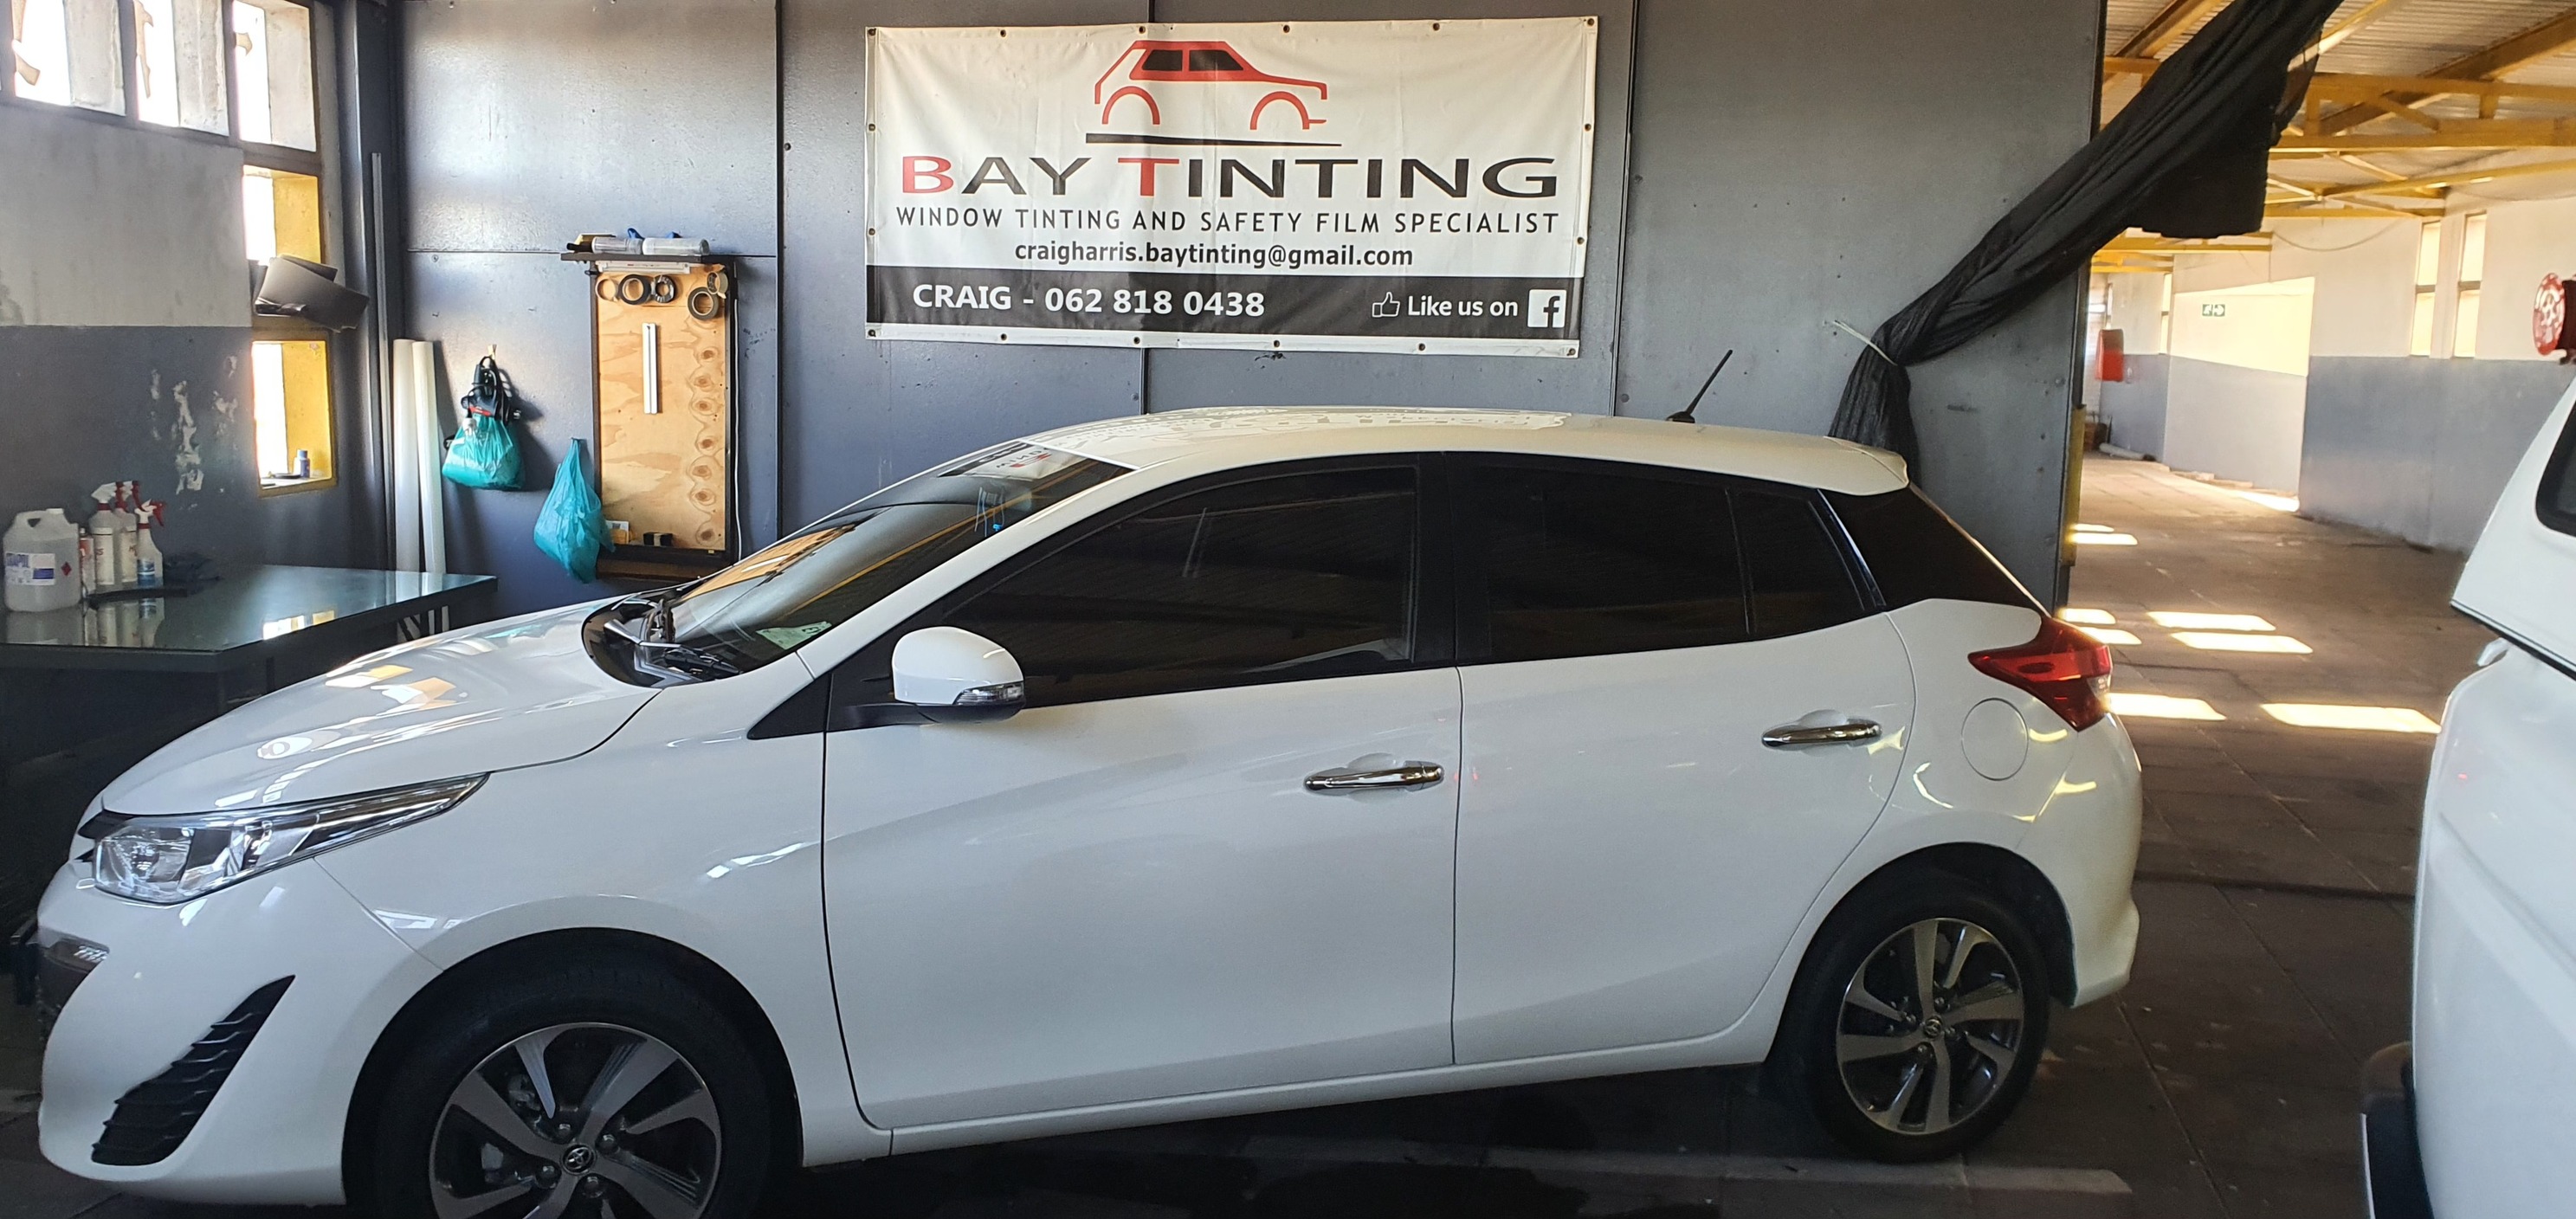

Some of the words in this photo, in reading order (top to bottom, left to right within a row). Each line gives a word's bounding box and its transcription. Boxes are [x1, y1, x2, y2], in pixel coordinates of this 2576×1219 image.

[902, 156, 1092, 196] BAY
[1118, 157, 1558, 198] TINTING
[896, 207, 1003, 228] WINDOW
[1015, 209, 1120, 230] TINTING
[1133, 210, 1186, 231] AND
[1200, 211, 1302, 232] SAFETY
[1317, 212, 1379, 233] FILM
[1395, 212, 1559, 234] SPECIALIST
[1015, 241, 1413, 269] craigharris.baytinting@gmail.com
[913, 284, 1012, 310] CRAIG
[1044, 287, 1103, 313] 062
[1113, 289, 1173, 314] 818
[1183, 291, 1265, 317] 0438
[1408, 295, 1452, 317] Like
[1458, 300, 1483, 317] us
[1489, 300, 1519, 317] on
